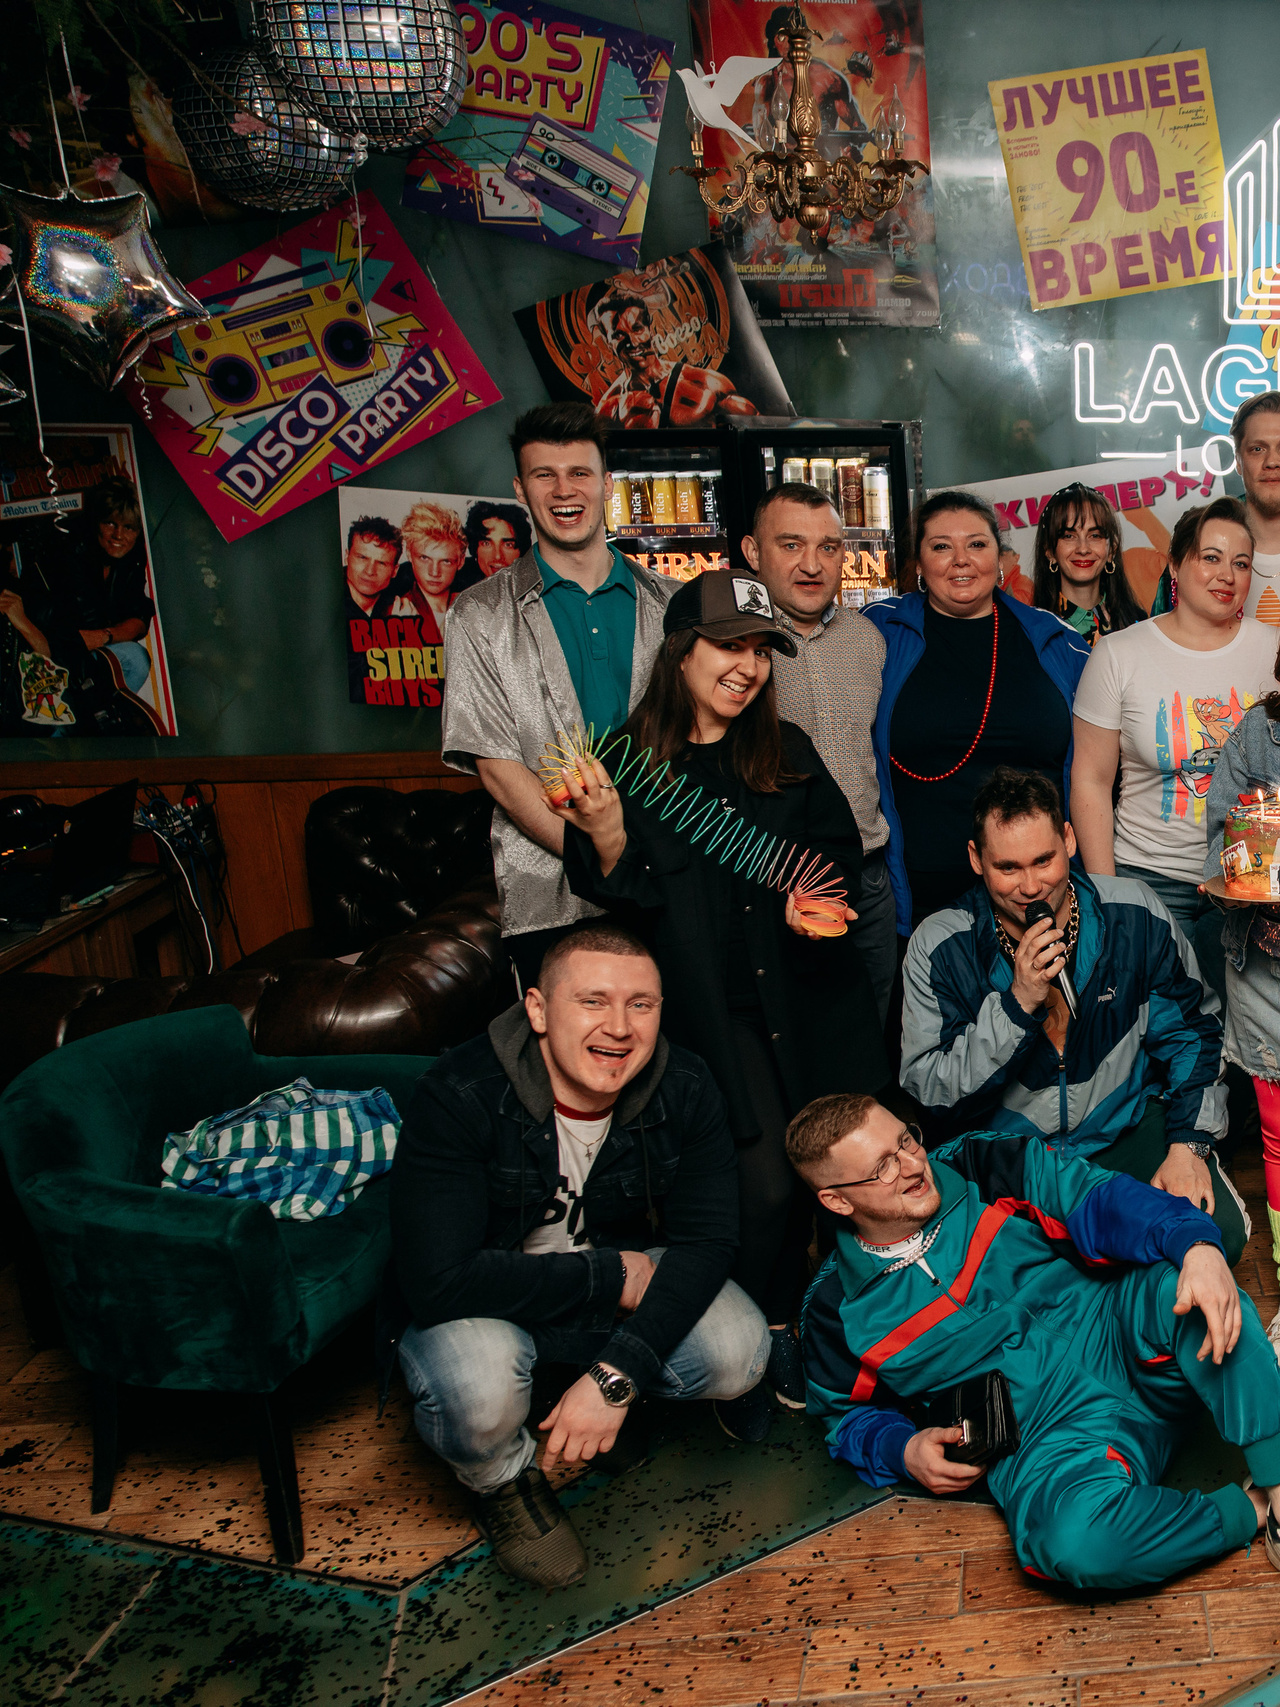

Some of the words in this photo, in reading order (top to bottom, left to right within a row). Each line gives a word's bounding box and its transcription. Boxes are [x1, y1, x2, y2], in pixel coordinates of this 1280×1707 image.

[456, 3, 586, 74] 90'S
[466, 62, 584, 113] ARTY
[1002, 59, 1206, 132] ЛУЧШЕЕ
[592, 198, 612, 213] STEREO
[1029, 220, 1233, 303] ВРЕМЯ
[877, 297, 912, 308] RAMBO
[337, 355, 438, 456] PARTY
[226, 390, 338, 499] DISCO
[2, 502, 39, 518] Modern
[612, 491, 622, 517] Rich
[632, 491, 642, 514] Rich
[655, 491, 666, 514] Rich
[680, 491, 689, 513] Rich
[704, 489, 713, 513] Rich
[621, 527, 642, 535] BURN
[655, 526, 677, 534] BURN
[689, 526, 711, 534] BURN
[861, 530, 883, 538] BURN
[841, 550, 888, 578] RN
[841, 579, 871, 589] DRINK
[349, 617, 424, 653] BACK
[366, 646, 445, 682] STRE
[363, 675, 441, 708] BOYS
